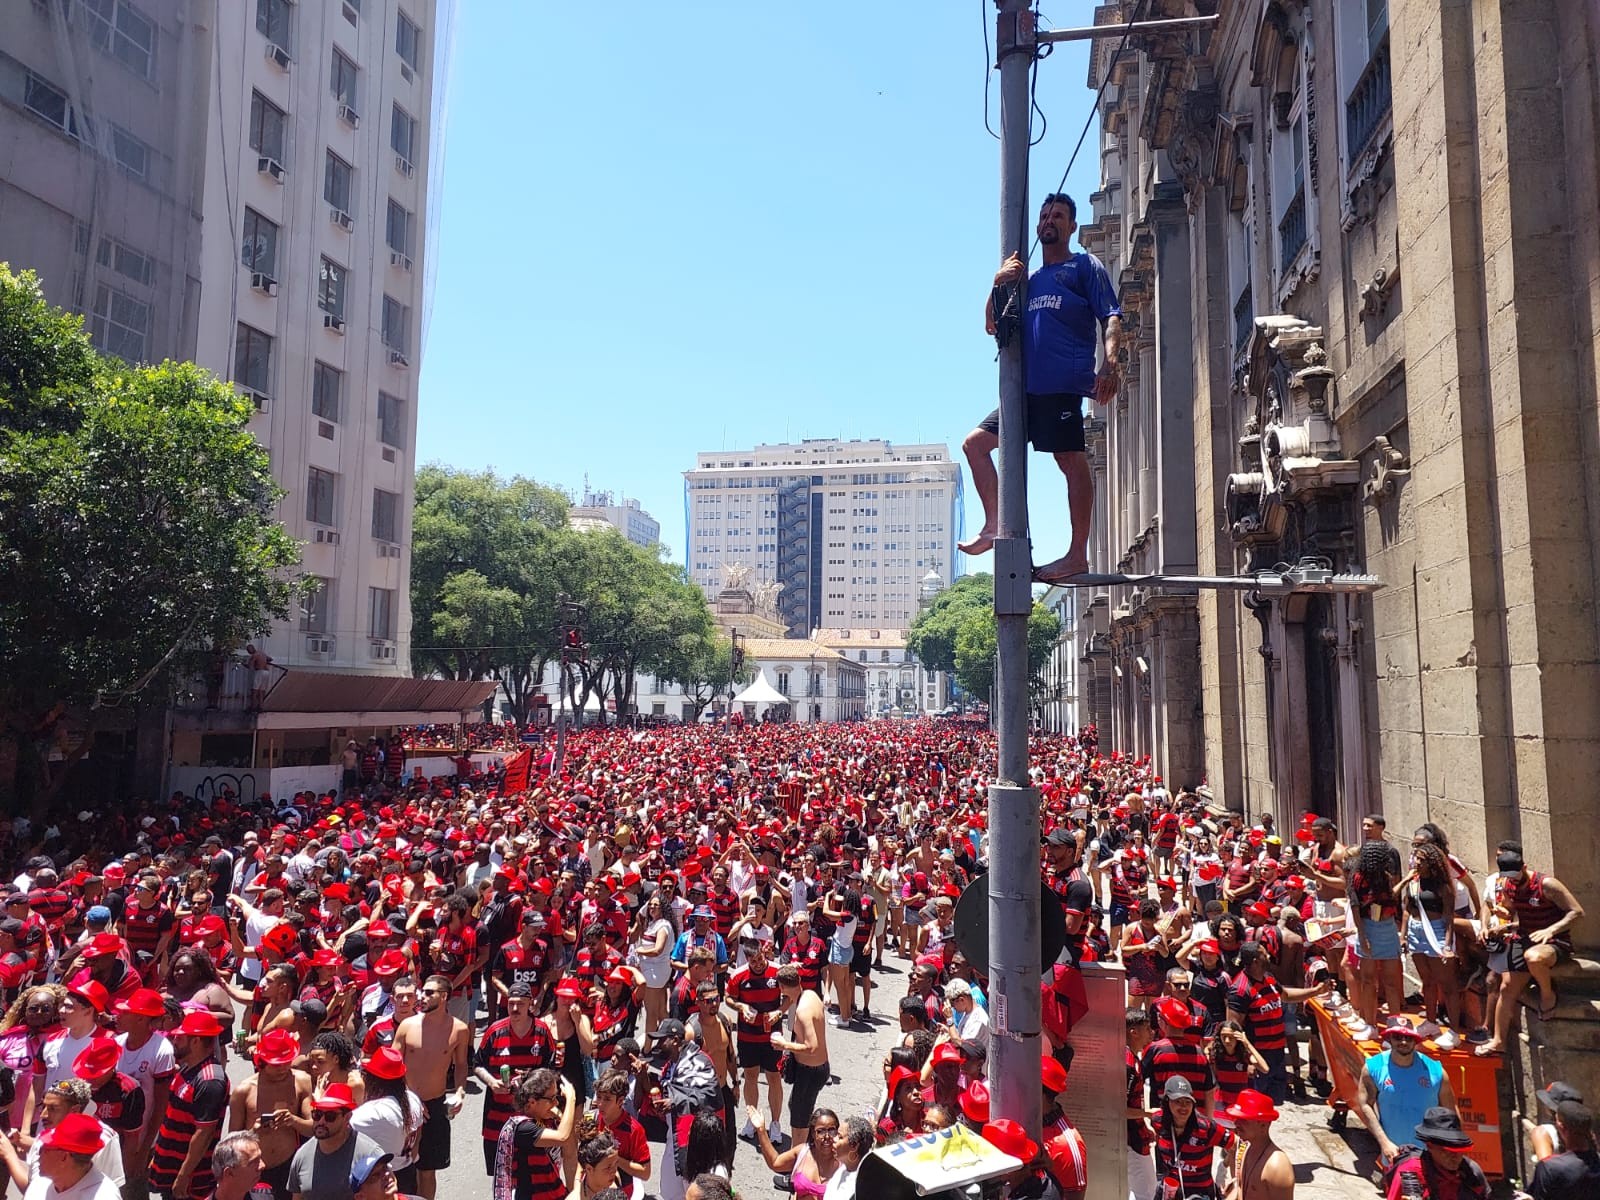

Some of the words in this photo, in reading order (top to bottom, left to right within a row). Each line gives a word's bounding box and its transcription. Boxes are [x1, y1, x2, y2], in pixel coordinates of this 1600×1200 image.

[1029, 295, 1063, 305] LOTERIAS
[1028, 301, 1062, 312] ONLINE
[513, 968, 537, 983] bs2
